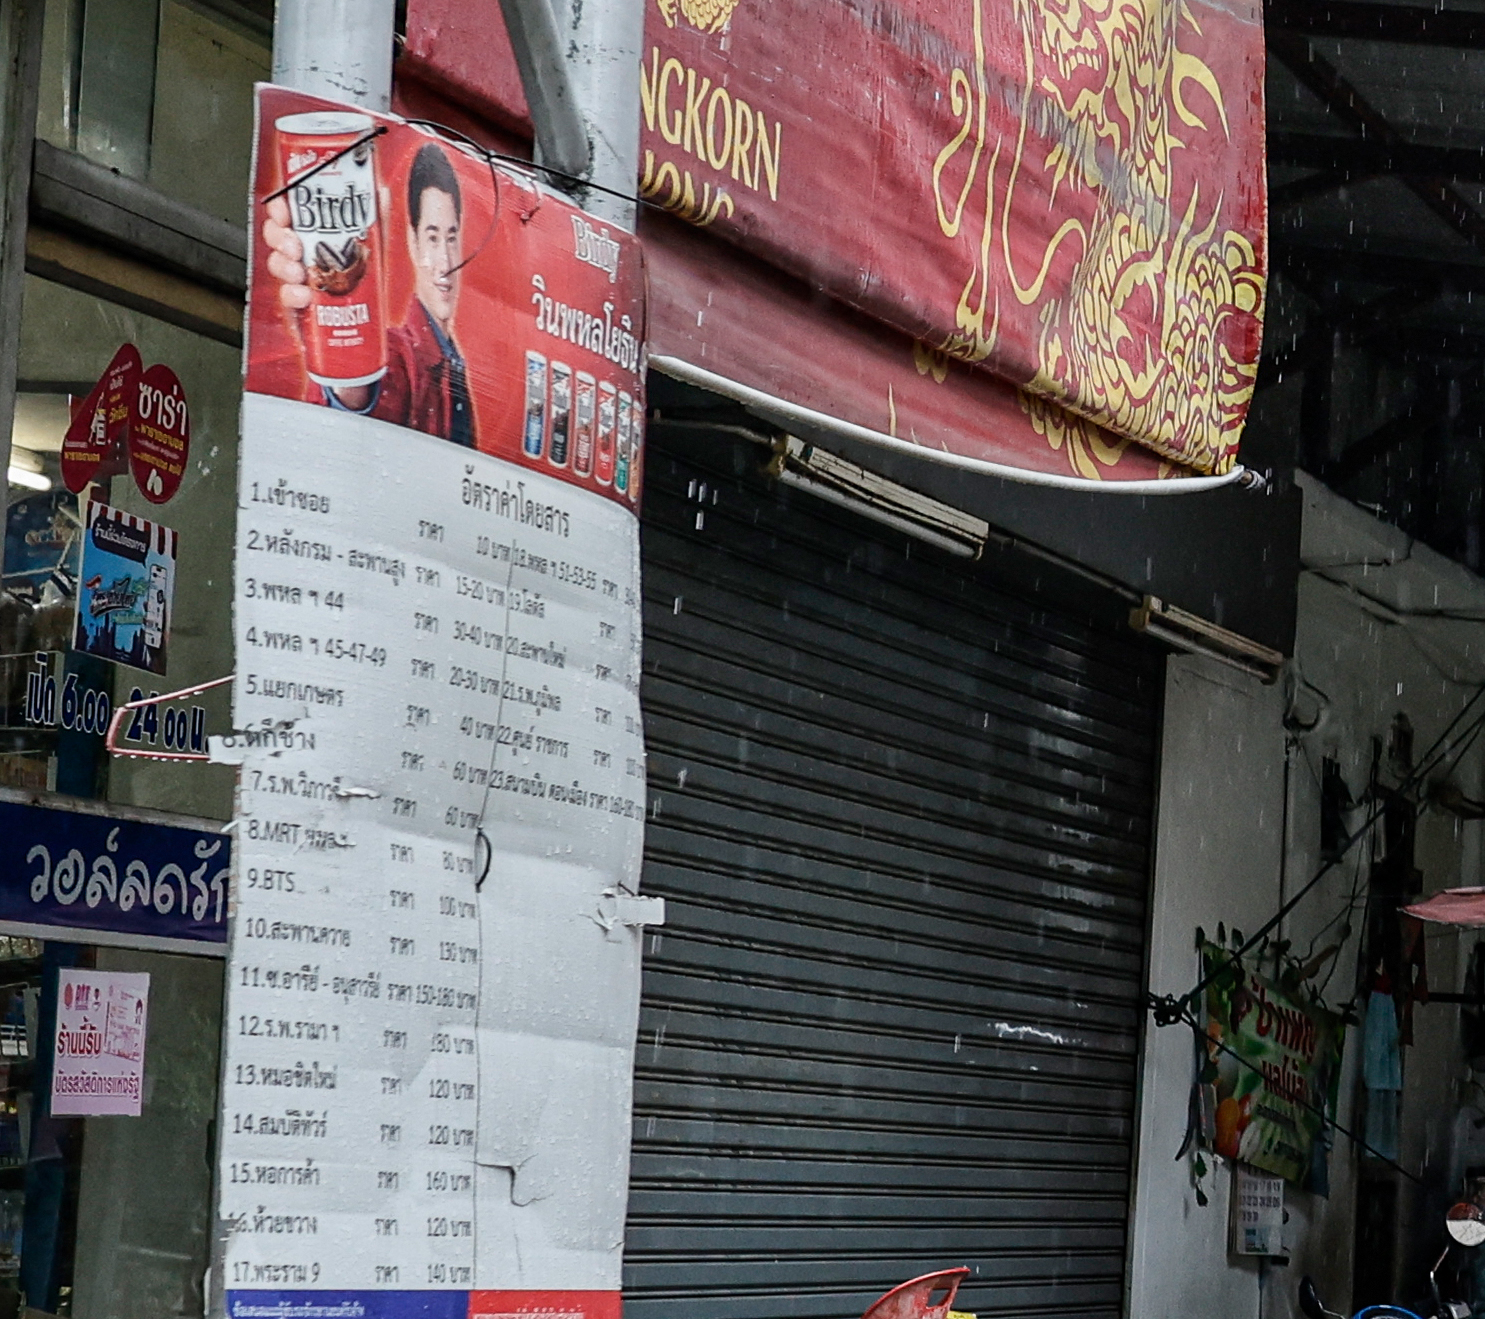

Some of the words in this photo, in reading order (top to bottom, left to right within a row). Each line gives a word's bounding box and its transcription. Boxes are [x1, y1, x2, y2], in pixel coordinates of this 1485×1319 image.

[641, 46, 782, 202] NGKORN
[294, 184, 373, 238] Birdy
[317, 303, 369, 327] ROBUSTA
[532, 274, 639, 374] วินพหลโยธิน
[139, 382, 187, 437] ซาร่า
[251, 478, 330, 513] 1.เข้าซอย
[461, 464, 570, 538] อัตราค่าโดยสาร
[246, 529, 331, 562] 2.หลังกรม
[244, 578, 301, 602] 3.พหล
[325, 591, 345, 610] 44
[246, 626, 303, 652] 4.พหล
[325, 638, 387, 668] 45-47-49
[60, 673, 111, 736] 6.00
[245, 674, 345, 707] 5.แยกเกษตร
[247, 818, 301, 844] 8.MRT
[247, 868, 296, 892] 9.BTS
[245, 918, 350, 947] 10.สะพานควาย
[57, 1014, 102, 1057] ร้านนี้รับ
[54, 1068, 140, 1106] บัตรสวัสดิการแห่งรัฐ
[235, 1061, 338, 1090] 13.หมอชิตใหม่
[230, 1158, 320, 1185] 15.หอการค้า
[232, 1261, 307, 1283] 17.พระราม
[311, 1262, 321, 1282] 9
